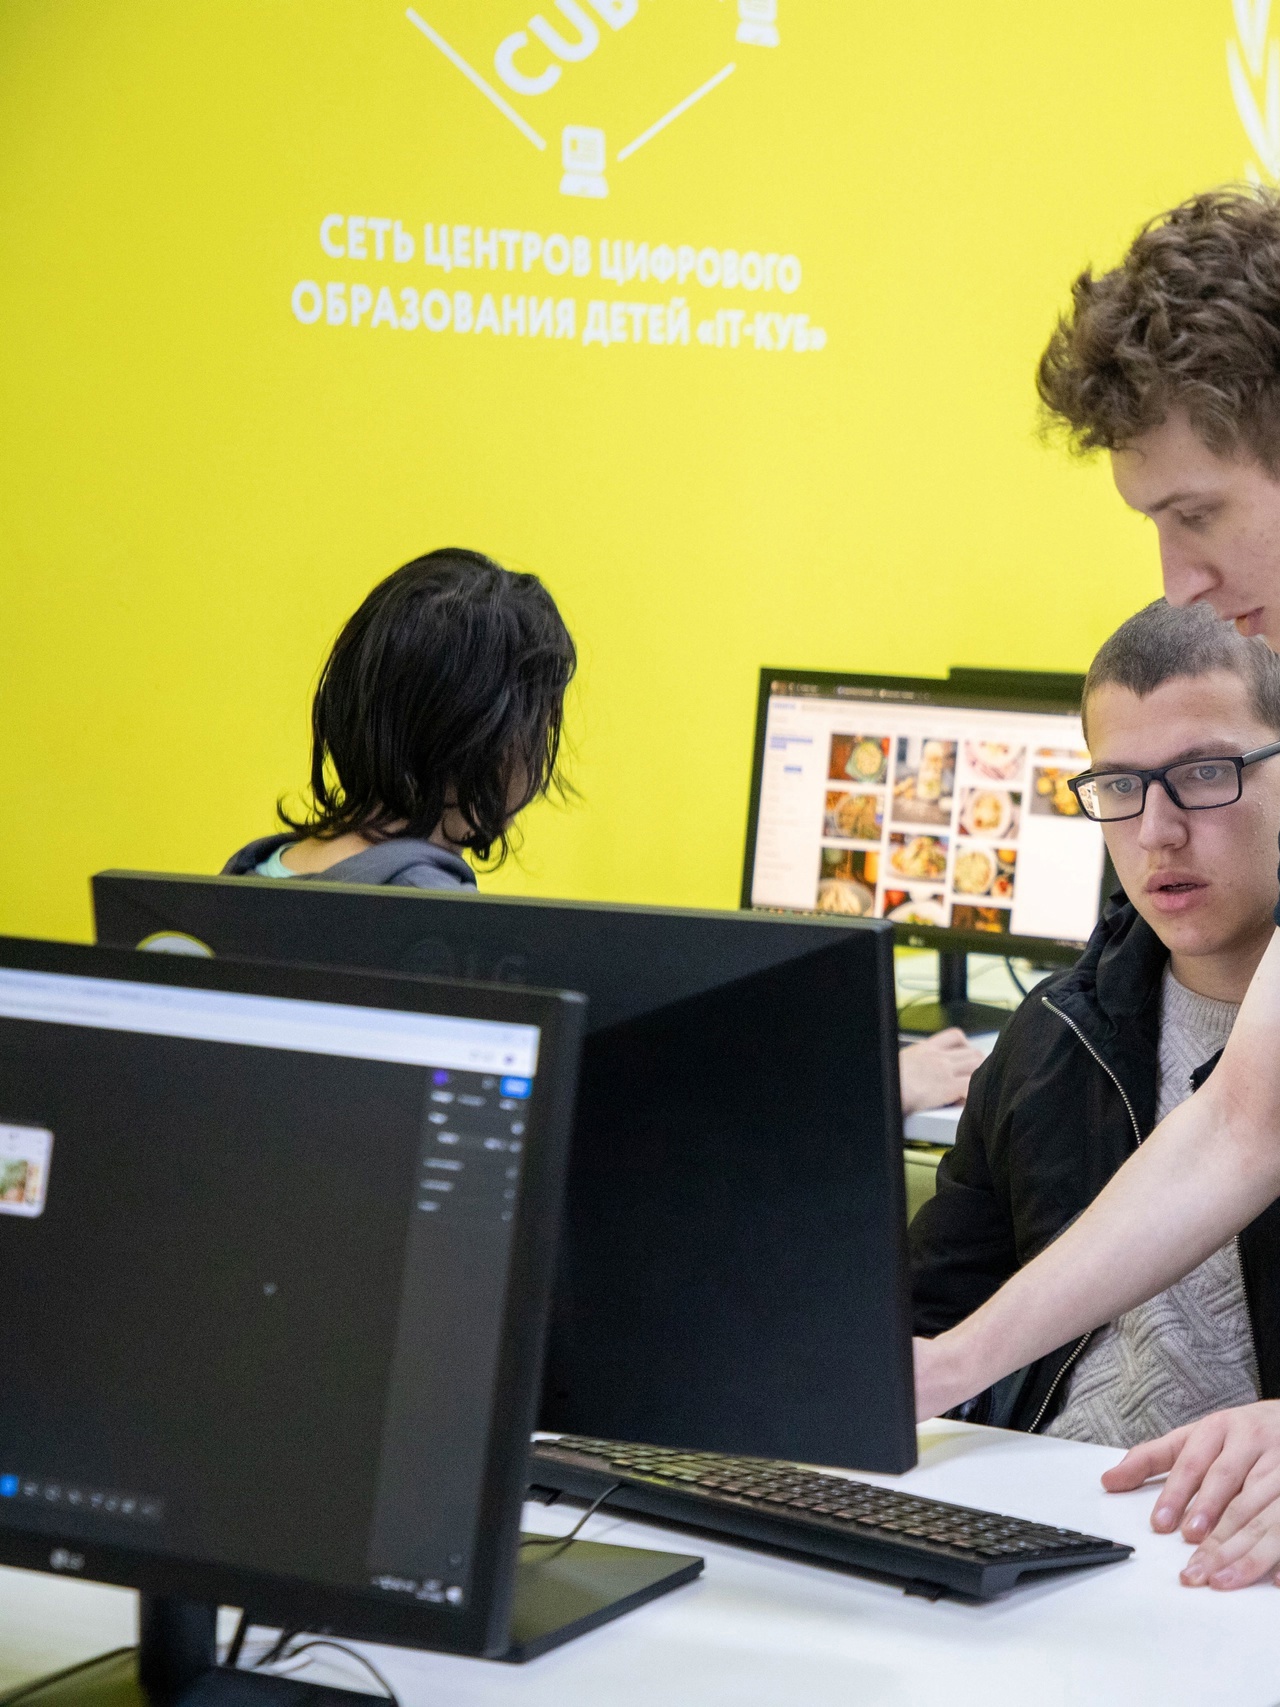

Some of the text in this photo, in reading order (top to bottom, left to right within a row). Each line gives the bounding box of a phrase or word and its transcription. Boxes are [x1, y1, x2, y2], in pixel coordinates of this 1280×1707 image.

[319, 213, 802, 294] СЕТЬ ЦЕНТРОВ ЦИФРОВОГО
[291, 279, 577, 340] ОБРАЗОВАНИЯ
[582, 296, 691, 348] ДЕТЕЙ
